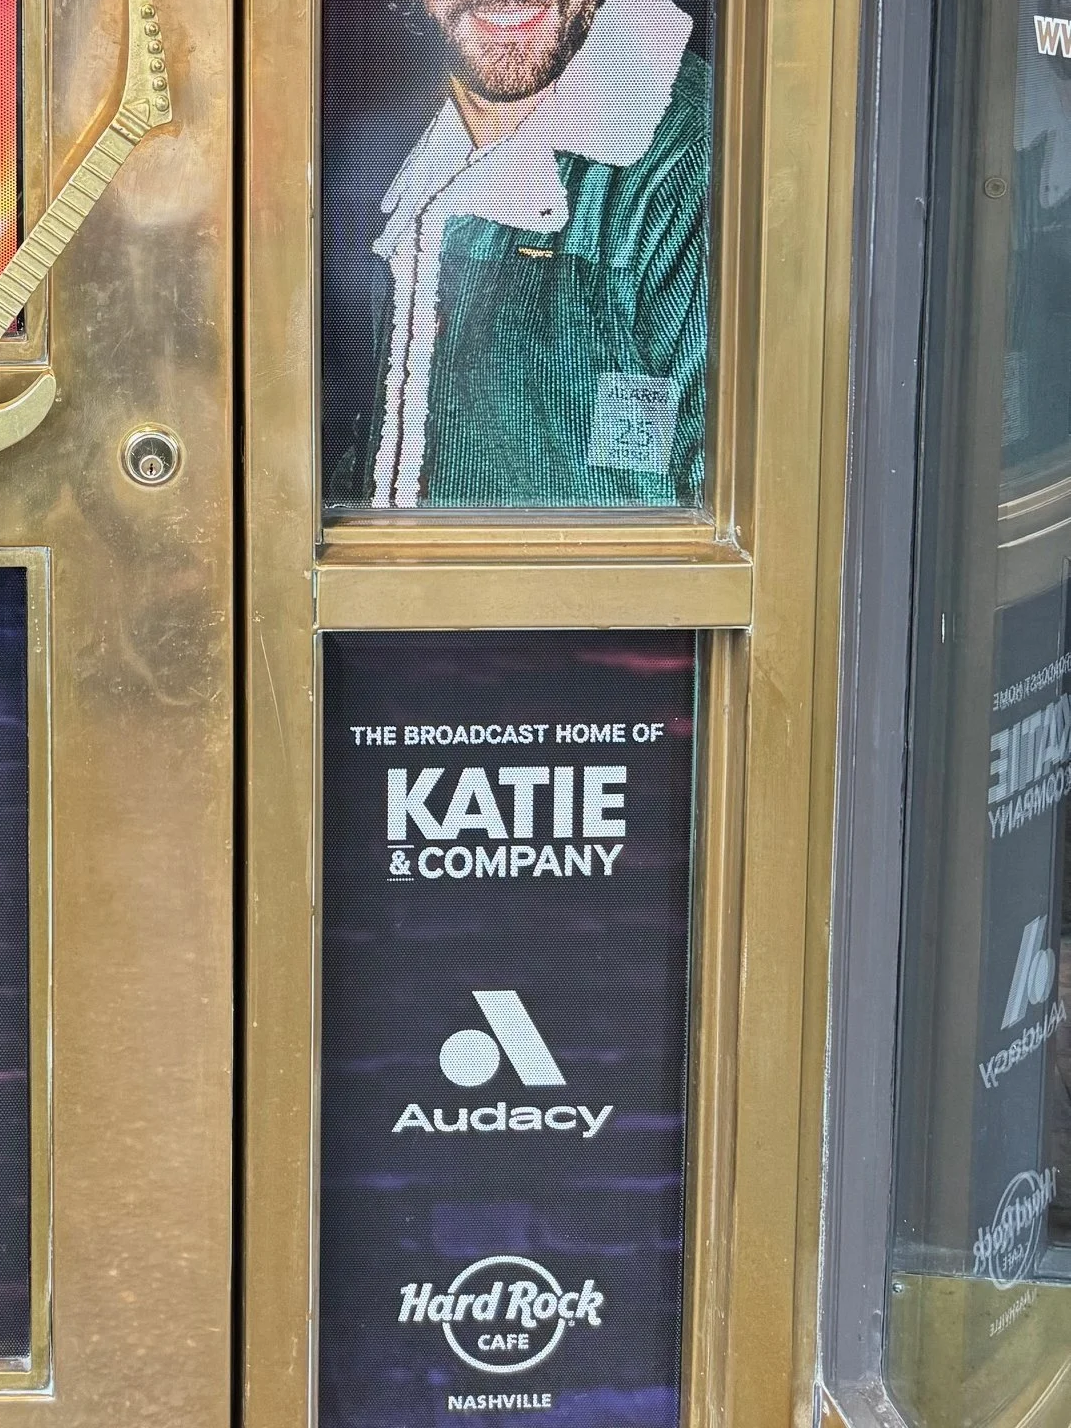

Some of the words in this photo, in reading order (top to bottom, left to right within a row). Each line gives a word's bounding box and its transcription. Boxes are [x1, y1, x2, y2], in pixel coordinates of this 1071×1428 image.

[350, 725, 397, 746] THE
[403, 723, 549, 745] BROADCAST
[555, 723, 626, 744] HOME
[632, 722, 664, 743] OF
[387, 765, 627, 841] KATIE
[389, 850, 412, 876] &
[417, 844, 624, 879] COMPANY
[391, 1102, 614, 1138] Audacy
[397, 1281, 504, 1322] Hard
[505, 1279, 604, 1328] Rock
[477, 1334, 530, 1351] CAFE
[448, 1393, 552, 1410] NASHVILLE
